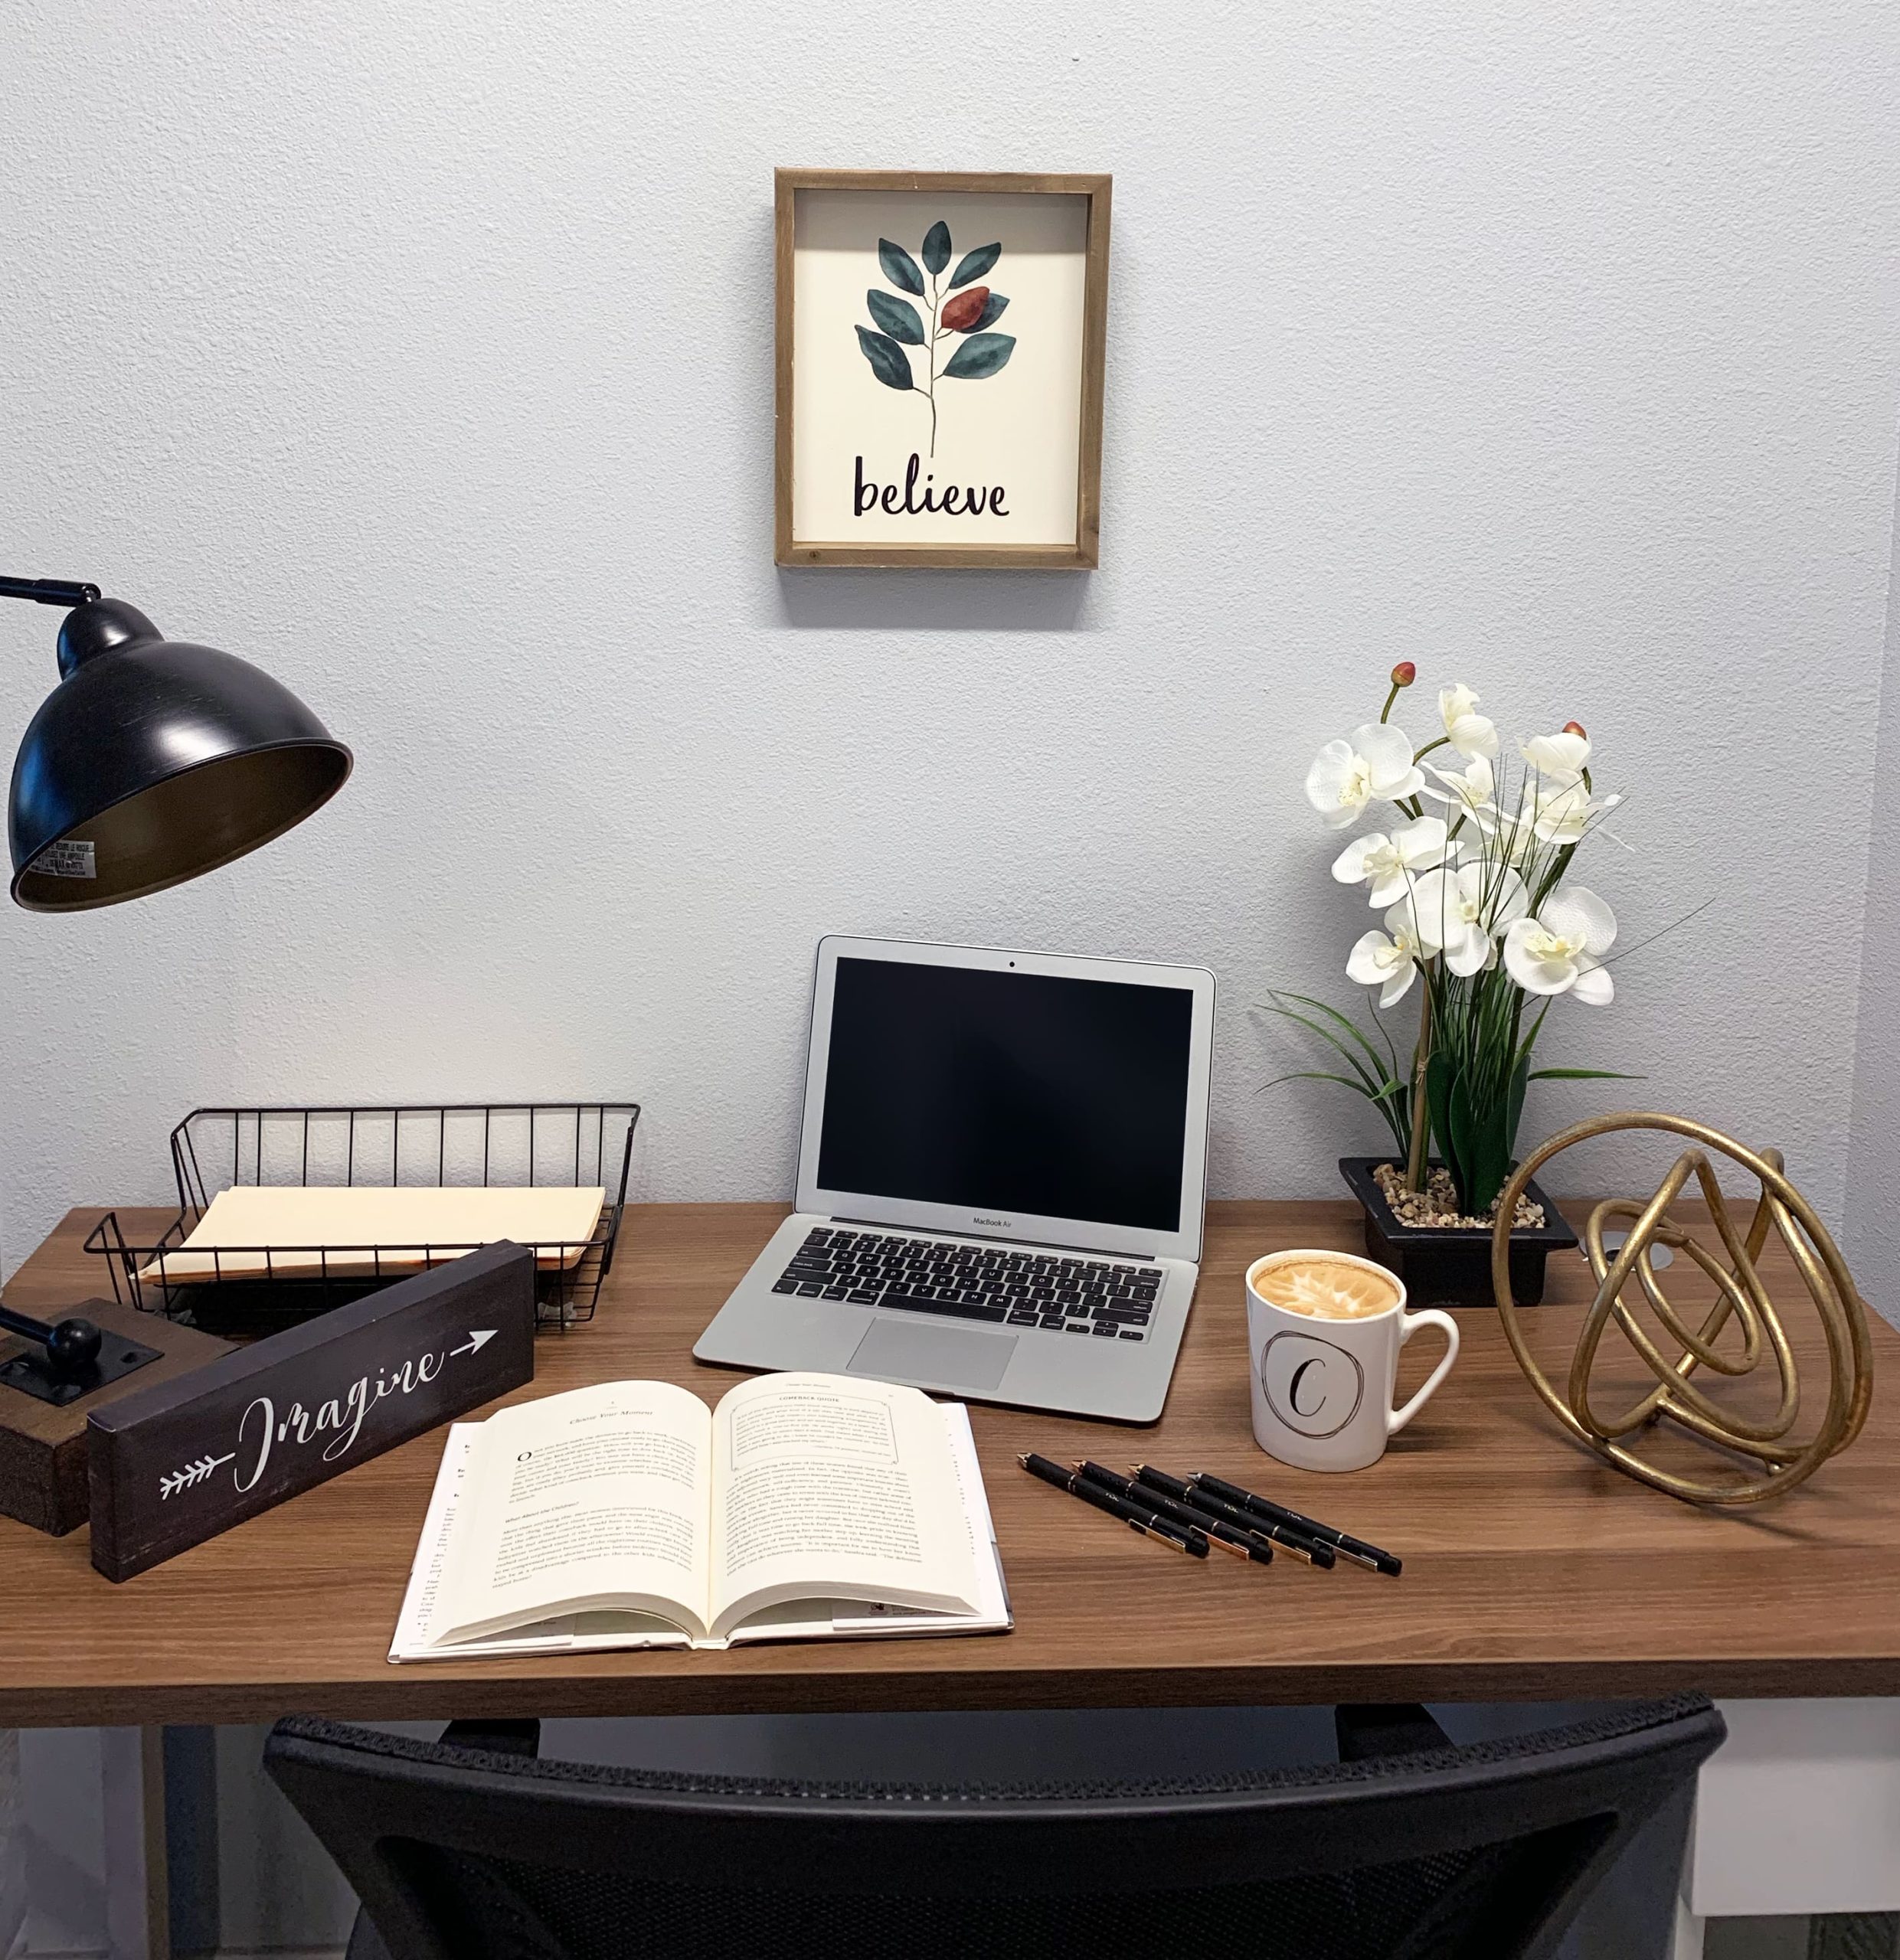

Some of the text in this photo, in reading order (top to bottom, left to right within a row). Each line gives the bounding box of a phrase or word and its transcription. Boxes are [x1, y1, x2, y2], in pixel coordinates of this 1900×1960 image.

[854, 452, 1010, 517] believe
[973, 1217, 1002, 1227] MacBook
[1290, 1358, 1326, 1416] C
[234, 1351, 444, 1492] Imagine
